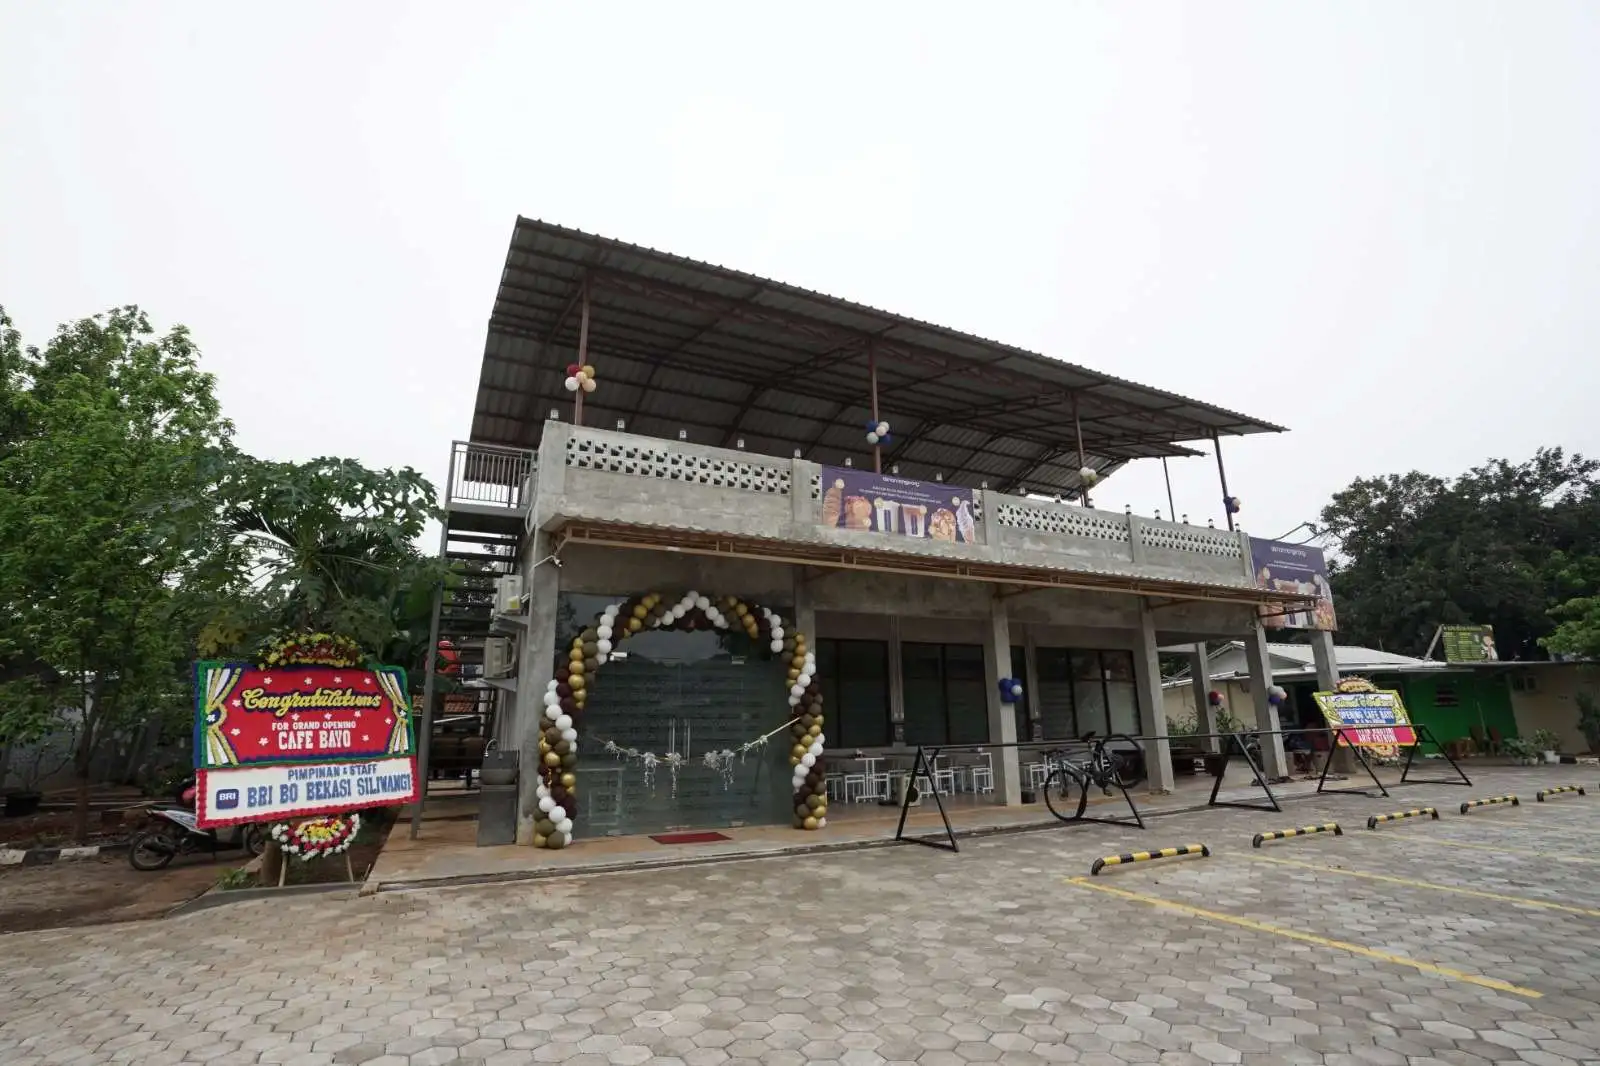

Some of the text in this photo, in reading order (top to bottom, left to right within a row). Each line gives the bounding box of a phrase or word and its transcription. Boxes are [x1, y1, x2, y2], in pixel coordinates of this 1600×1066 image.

[272, 721, 356, 731] FOR GRAND OPENING
[278, 730, 351, 750] CAFE BAYO
[288, 768, 340, 780] PIMPINAN
[350, 764, 377, 777] STAFF
[219, 793, 236, 801] BRI
[247, 773, 411, 808] BRI BO BEKASI SILIWANGI
